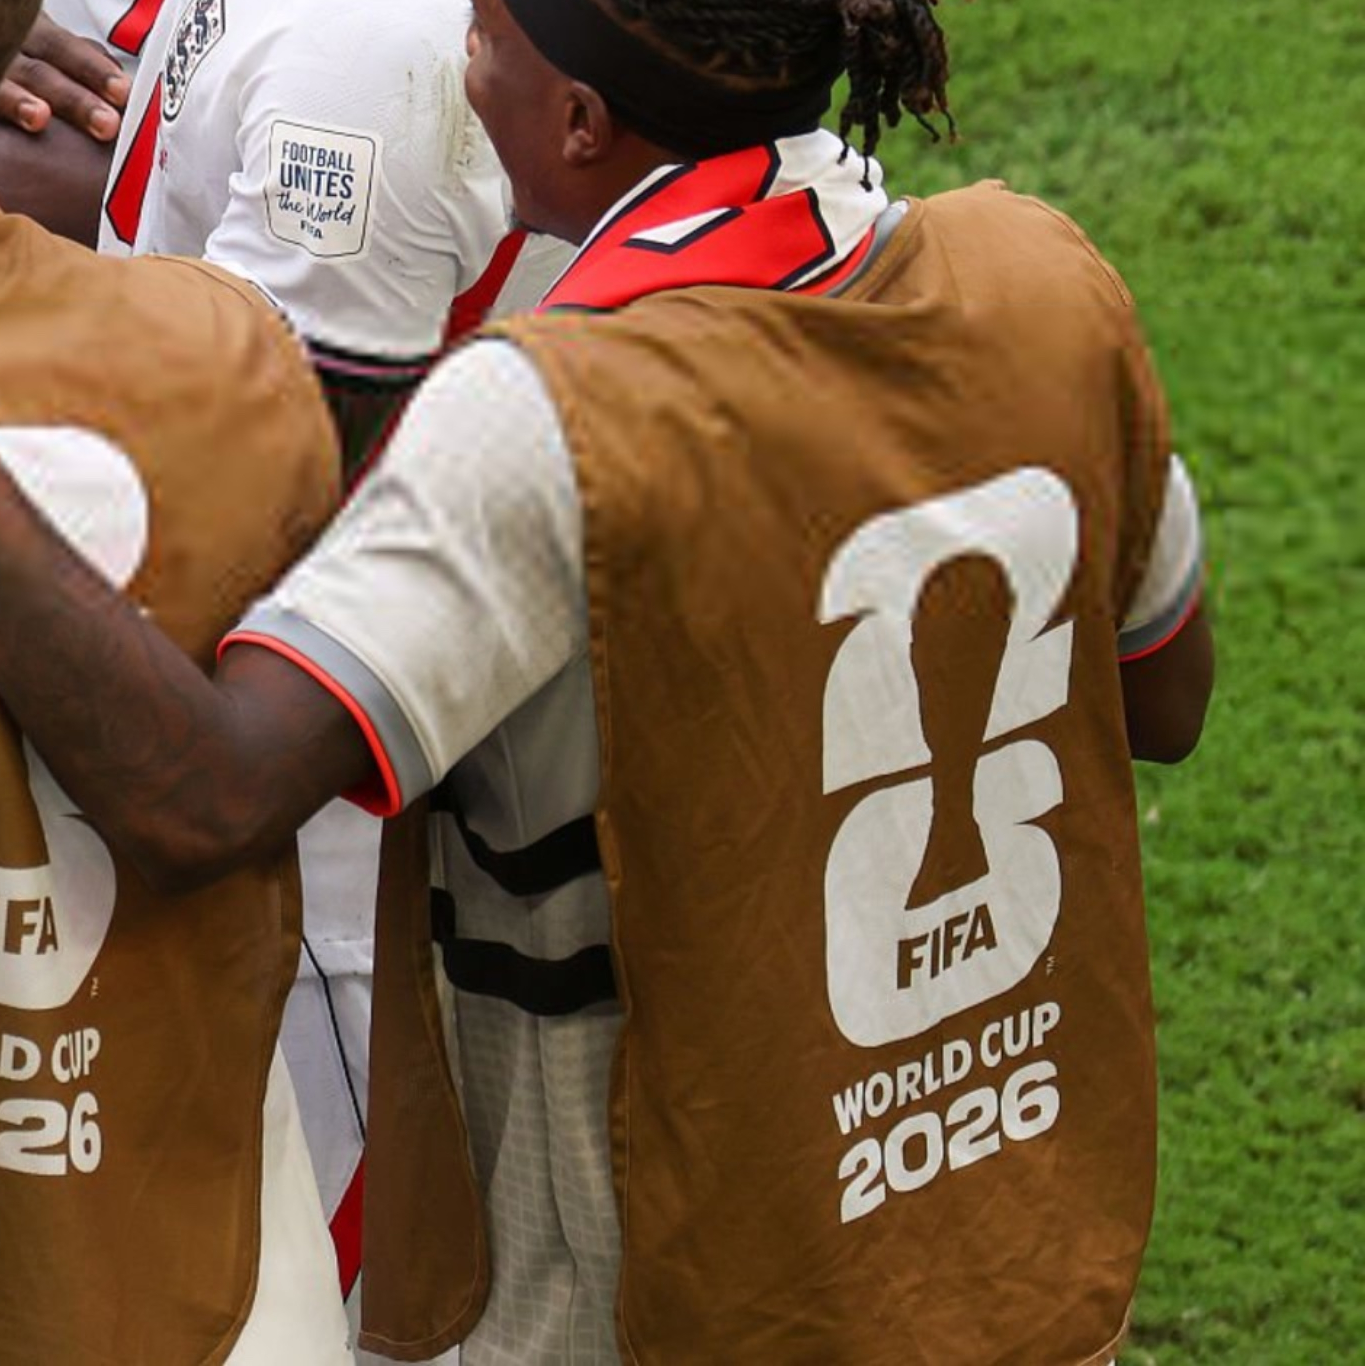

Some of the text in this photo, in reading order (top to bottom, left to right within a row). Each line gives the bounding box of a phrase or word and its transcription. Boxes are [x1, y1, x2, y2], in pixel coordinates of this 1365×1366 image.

[280, 162, 354, 200] UNITES
[282, 140, 355, 174] FOOTBALL
[277, 191, 356, 226] the World
[897, 903, 998, 991] FIFA
[51, 1027, 101, 1084] CUP
[832, 1001, 1061, 1136] WORLD CUP
[837, 1060, 1061, 1224] 2026
